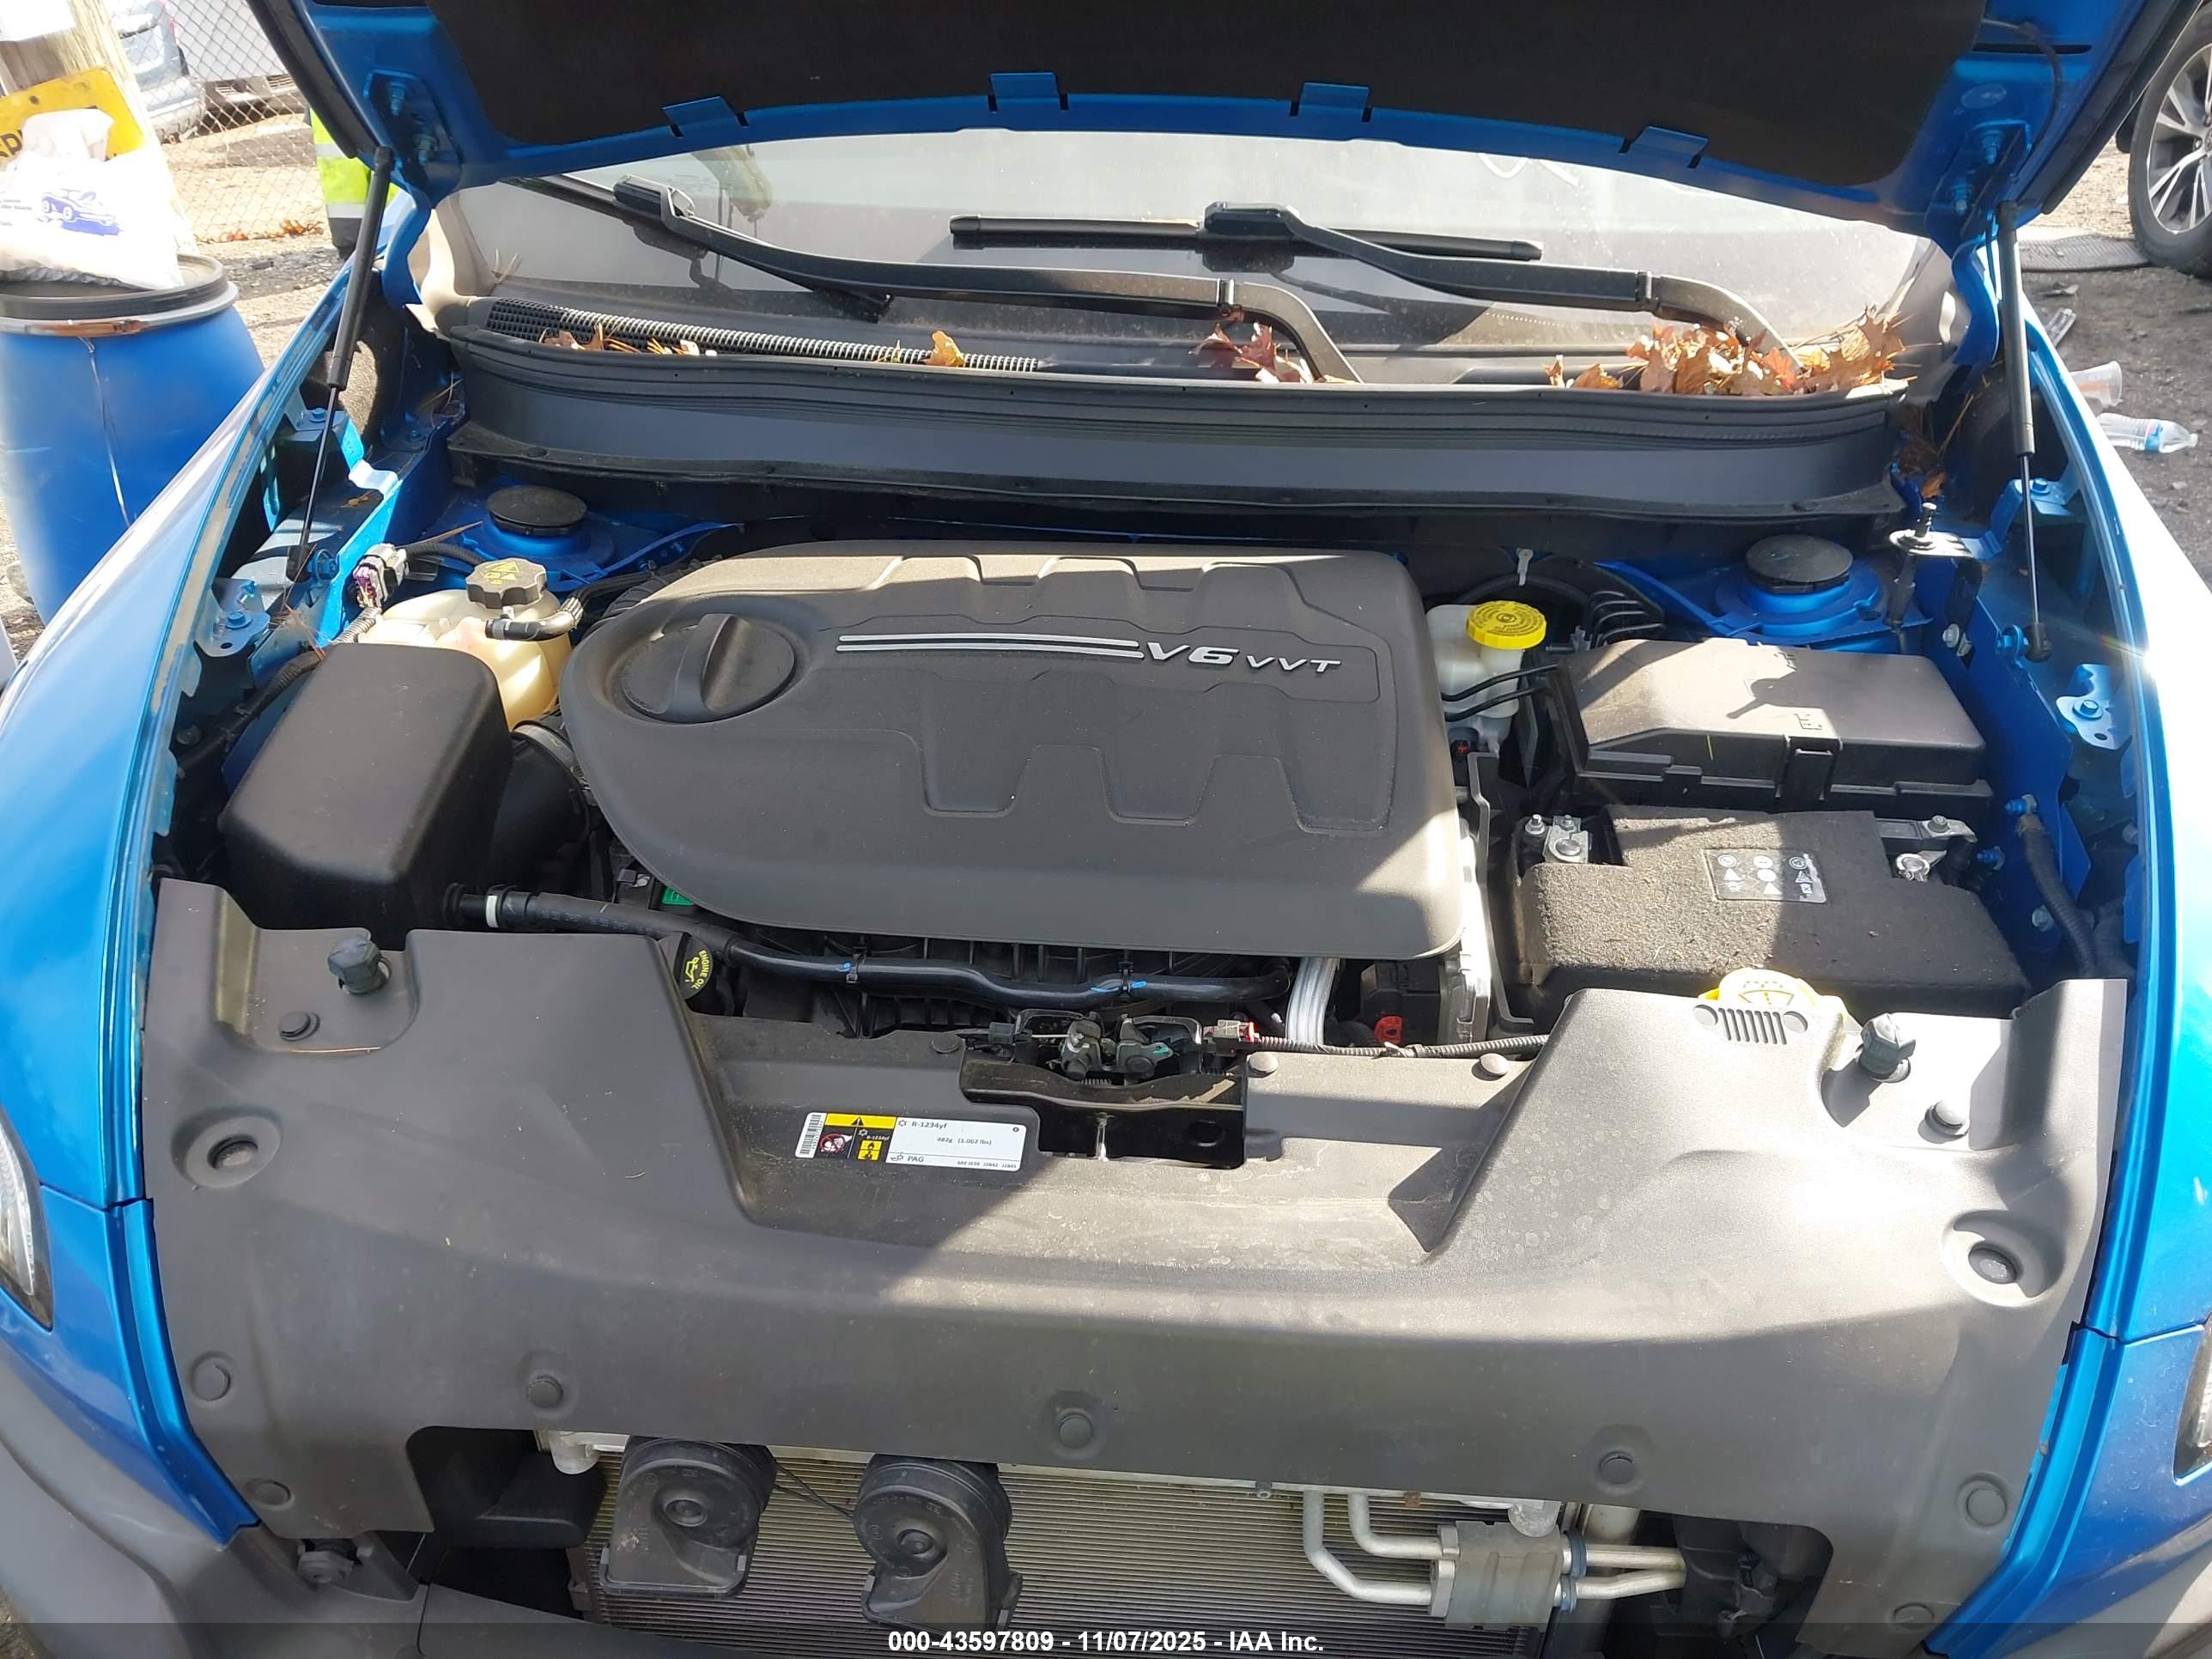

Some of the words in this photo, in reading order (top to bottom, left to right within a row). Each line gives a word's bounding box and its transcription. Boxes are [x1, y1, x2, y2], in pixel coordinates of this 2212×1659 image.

[1146, 641, 1240, 665] V6
[1247, 655, 1341, 672] VVT
[699, 950, 710, 978] ENGINE
[690, 978, 705, 990] OIL
[911, 1121, 948, 1129] R-1234yf
